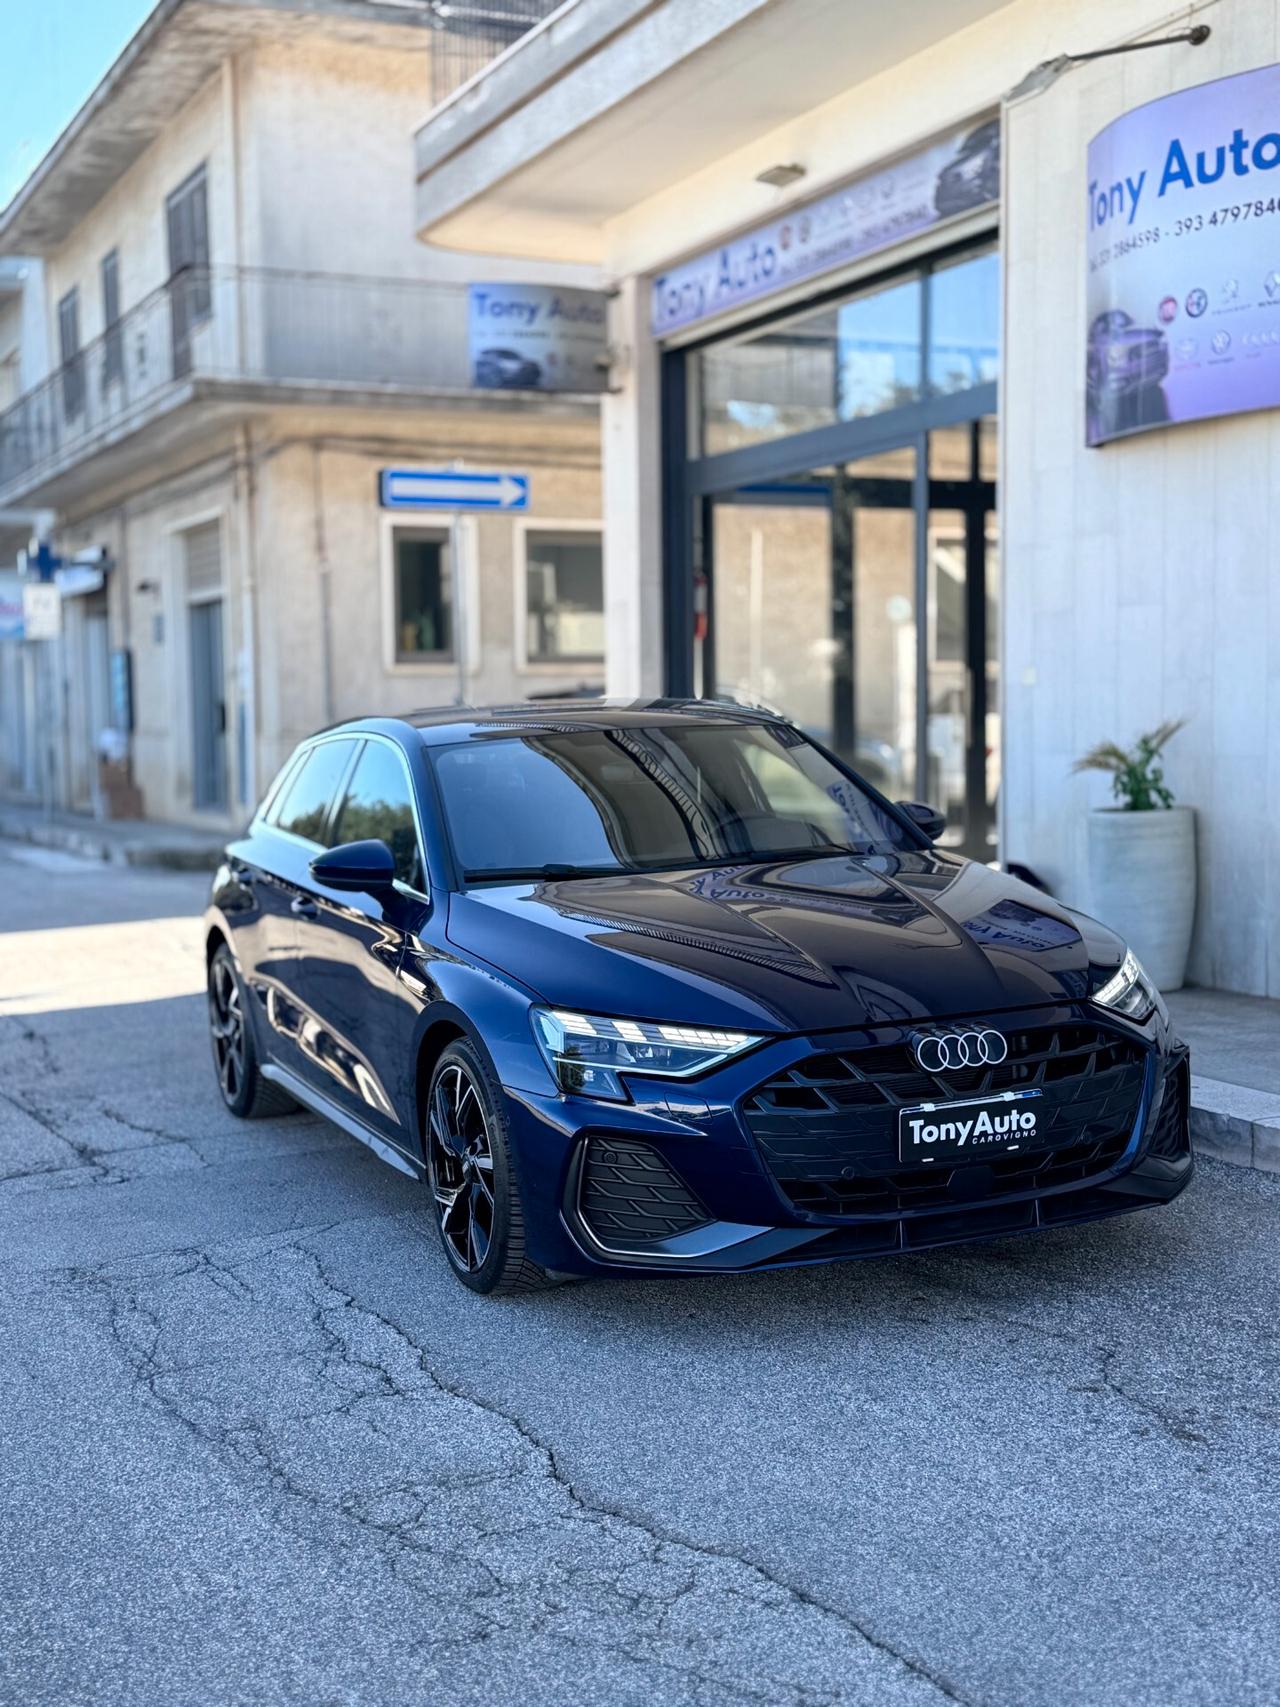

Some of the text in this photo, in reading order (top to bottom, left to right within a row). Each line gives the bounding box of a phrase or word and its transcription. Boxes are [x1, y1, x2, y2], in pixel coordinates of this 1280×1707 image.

[1088, 128, 1280, 232] Tony Auto
[1174, 214, 1203, 236] 393
[655, 246, 776, 321] Tony Auto
[475, 293, 540, 325] Tony
[972, 1129, 1037, 1145] CAROVIGNO
